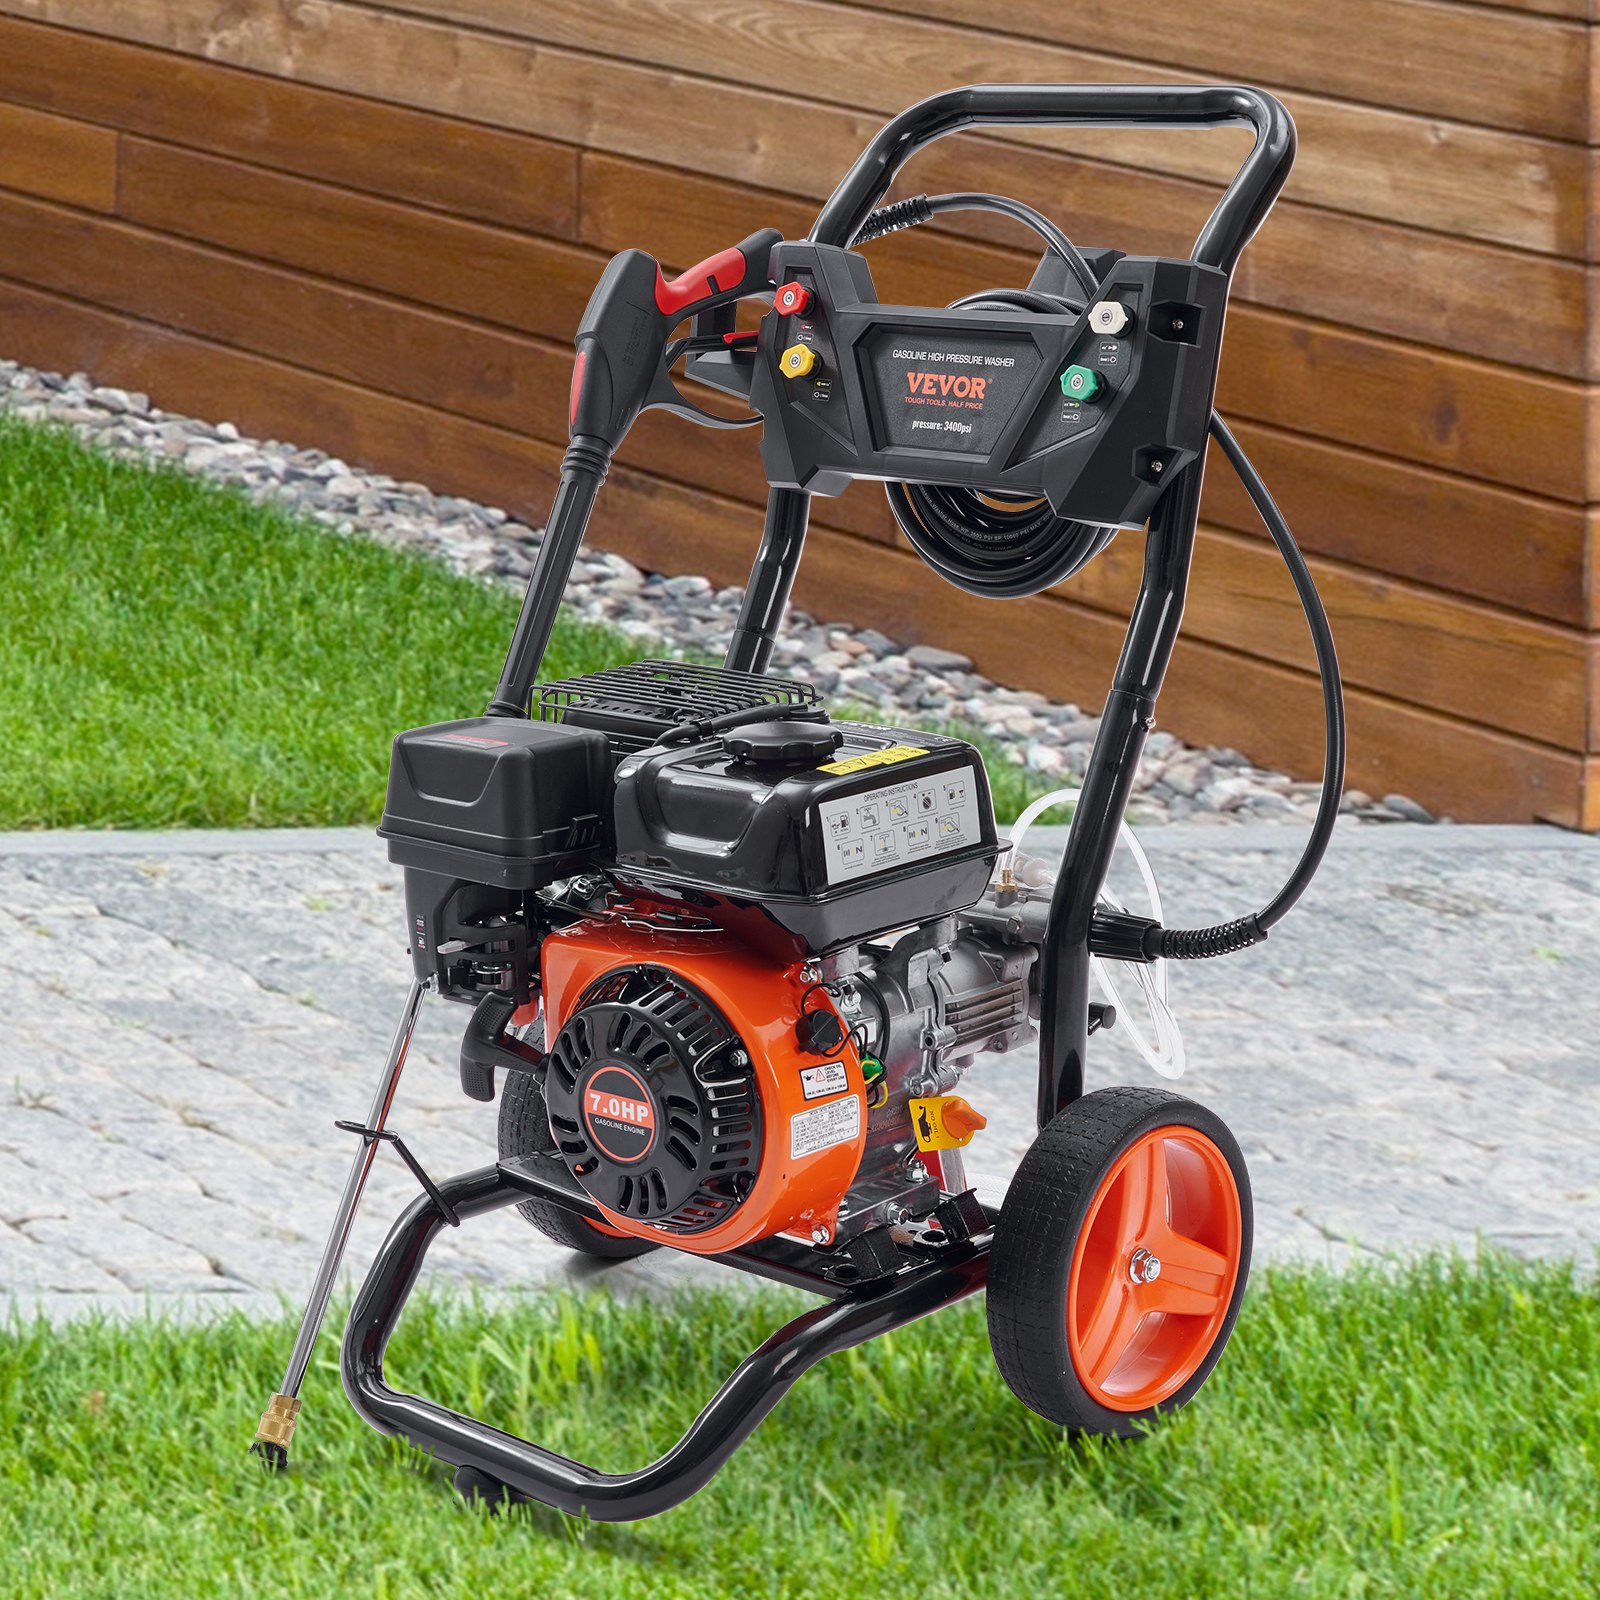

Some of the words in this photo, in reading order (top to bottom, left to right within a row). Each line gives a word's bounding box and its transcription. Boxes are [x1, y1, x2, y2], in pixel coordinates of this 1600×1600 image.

[893, 349, 927, 361] GASOLINE
[928, 353, 945, 362] HIGH
[946, 354, 983, 365] PRESSURE
[984, 356, 1015, 367] WASHER
[907, 371, 987, 399] VEVOR
[904, 396, 925, 405] TOUGH
[926, 398, 946, 407] TOOLS,
[965, 402, 983, 410] PRICE
[912, 420, 942, 430] pressure:
[944, 421, 972, 434] 3400psi
[863, 789, 887, 802] OPERATING
[888, 782, 918, 797] INSTRUCTIONS
[921, 827, 928, 836] N
[856, 845, 863, 854] N
[590, 1093, 649, 1122] 7.0HP
[929, 1110, 935, 1121] NO
[594, 1117, 623, 1130] GASOLINE
[623, 1124, 645, 1136] ENGINE
